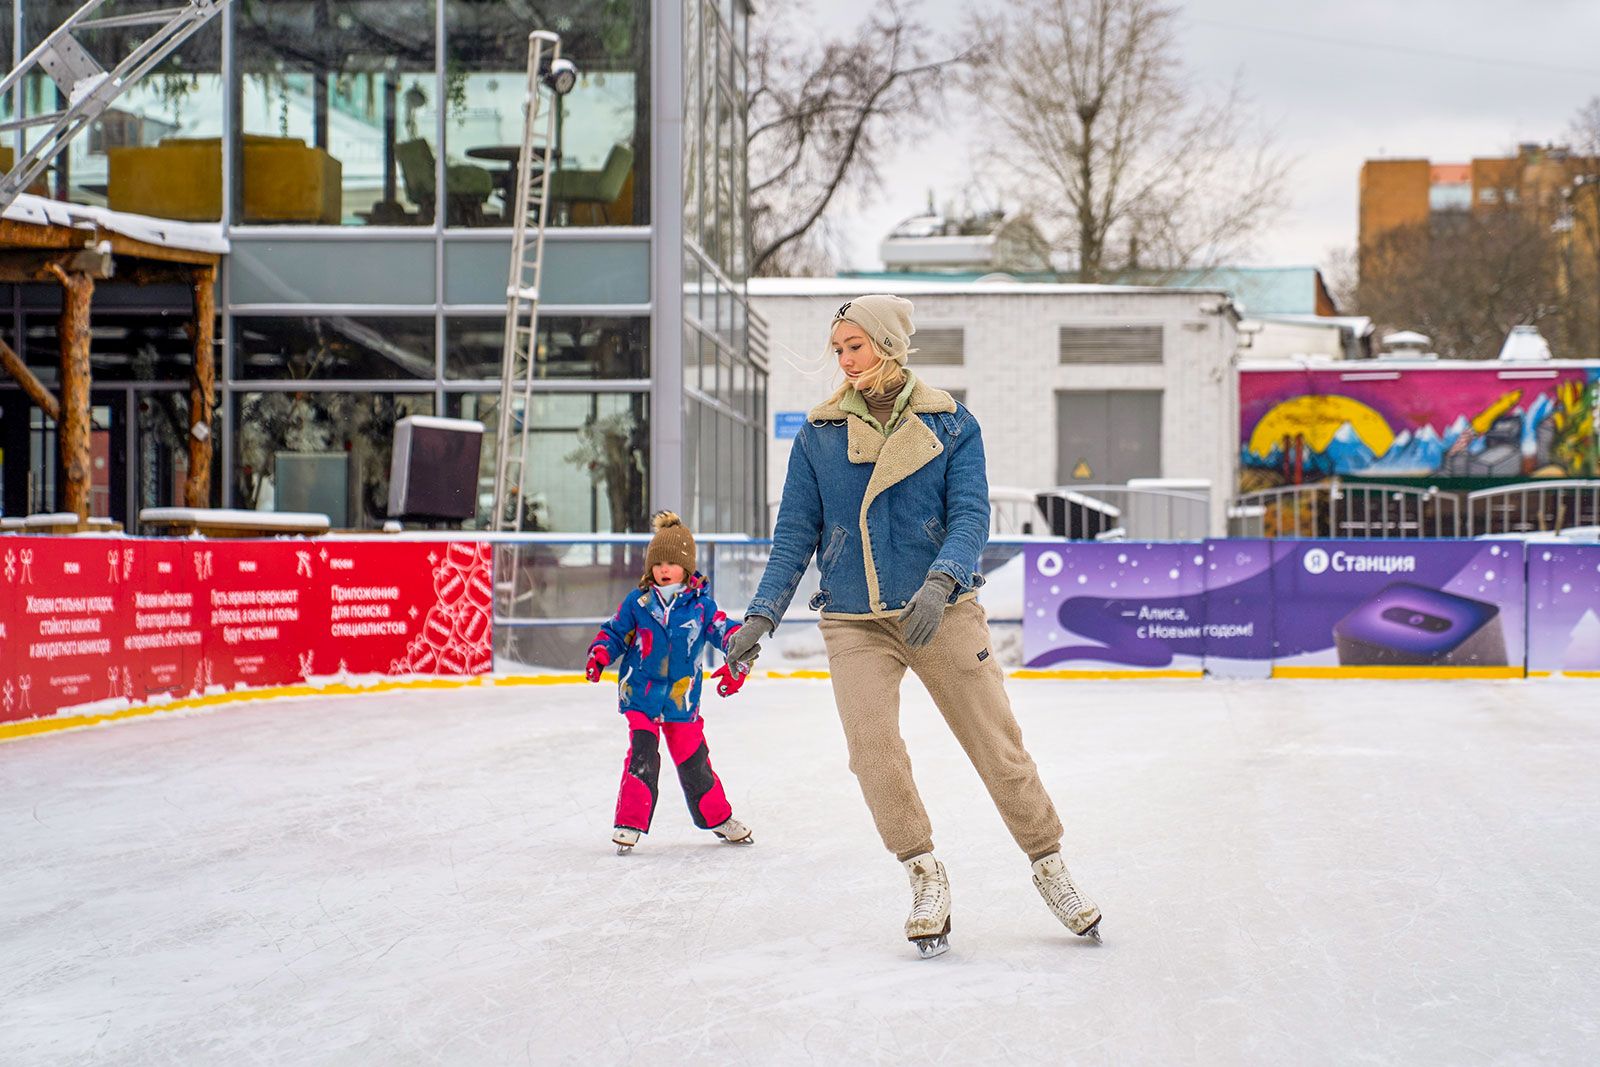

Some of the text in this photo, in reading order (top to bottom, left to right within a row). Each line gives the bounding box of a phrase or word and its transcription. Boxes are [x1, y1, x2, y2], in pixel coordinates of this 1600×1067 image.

[1331, 551, 1415, 574] Станция
[257, 589, 298, 606] сверкают
[331, 585, 400, 603] Приложение
[331, 604, 390, 620] для поиска
[1138, 605, 1189, 621] Алиса,
[40, 616, 70, 635] стойкого
[331, 621, 407, 637] специалистов
[1136, 622, 1253, 639] с Новым годом!
[35, 640, 76, 660] аккуратного
